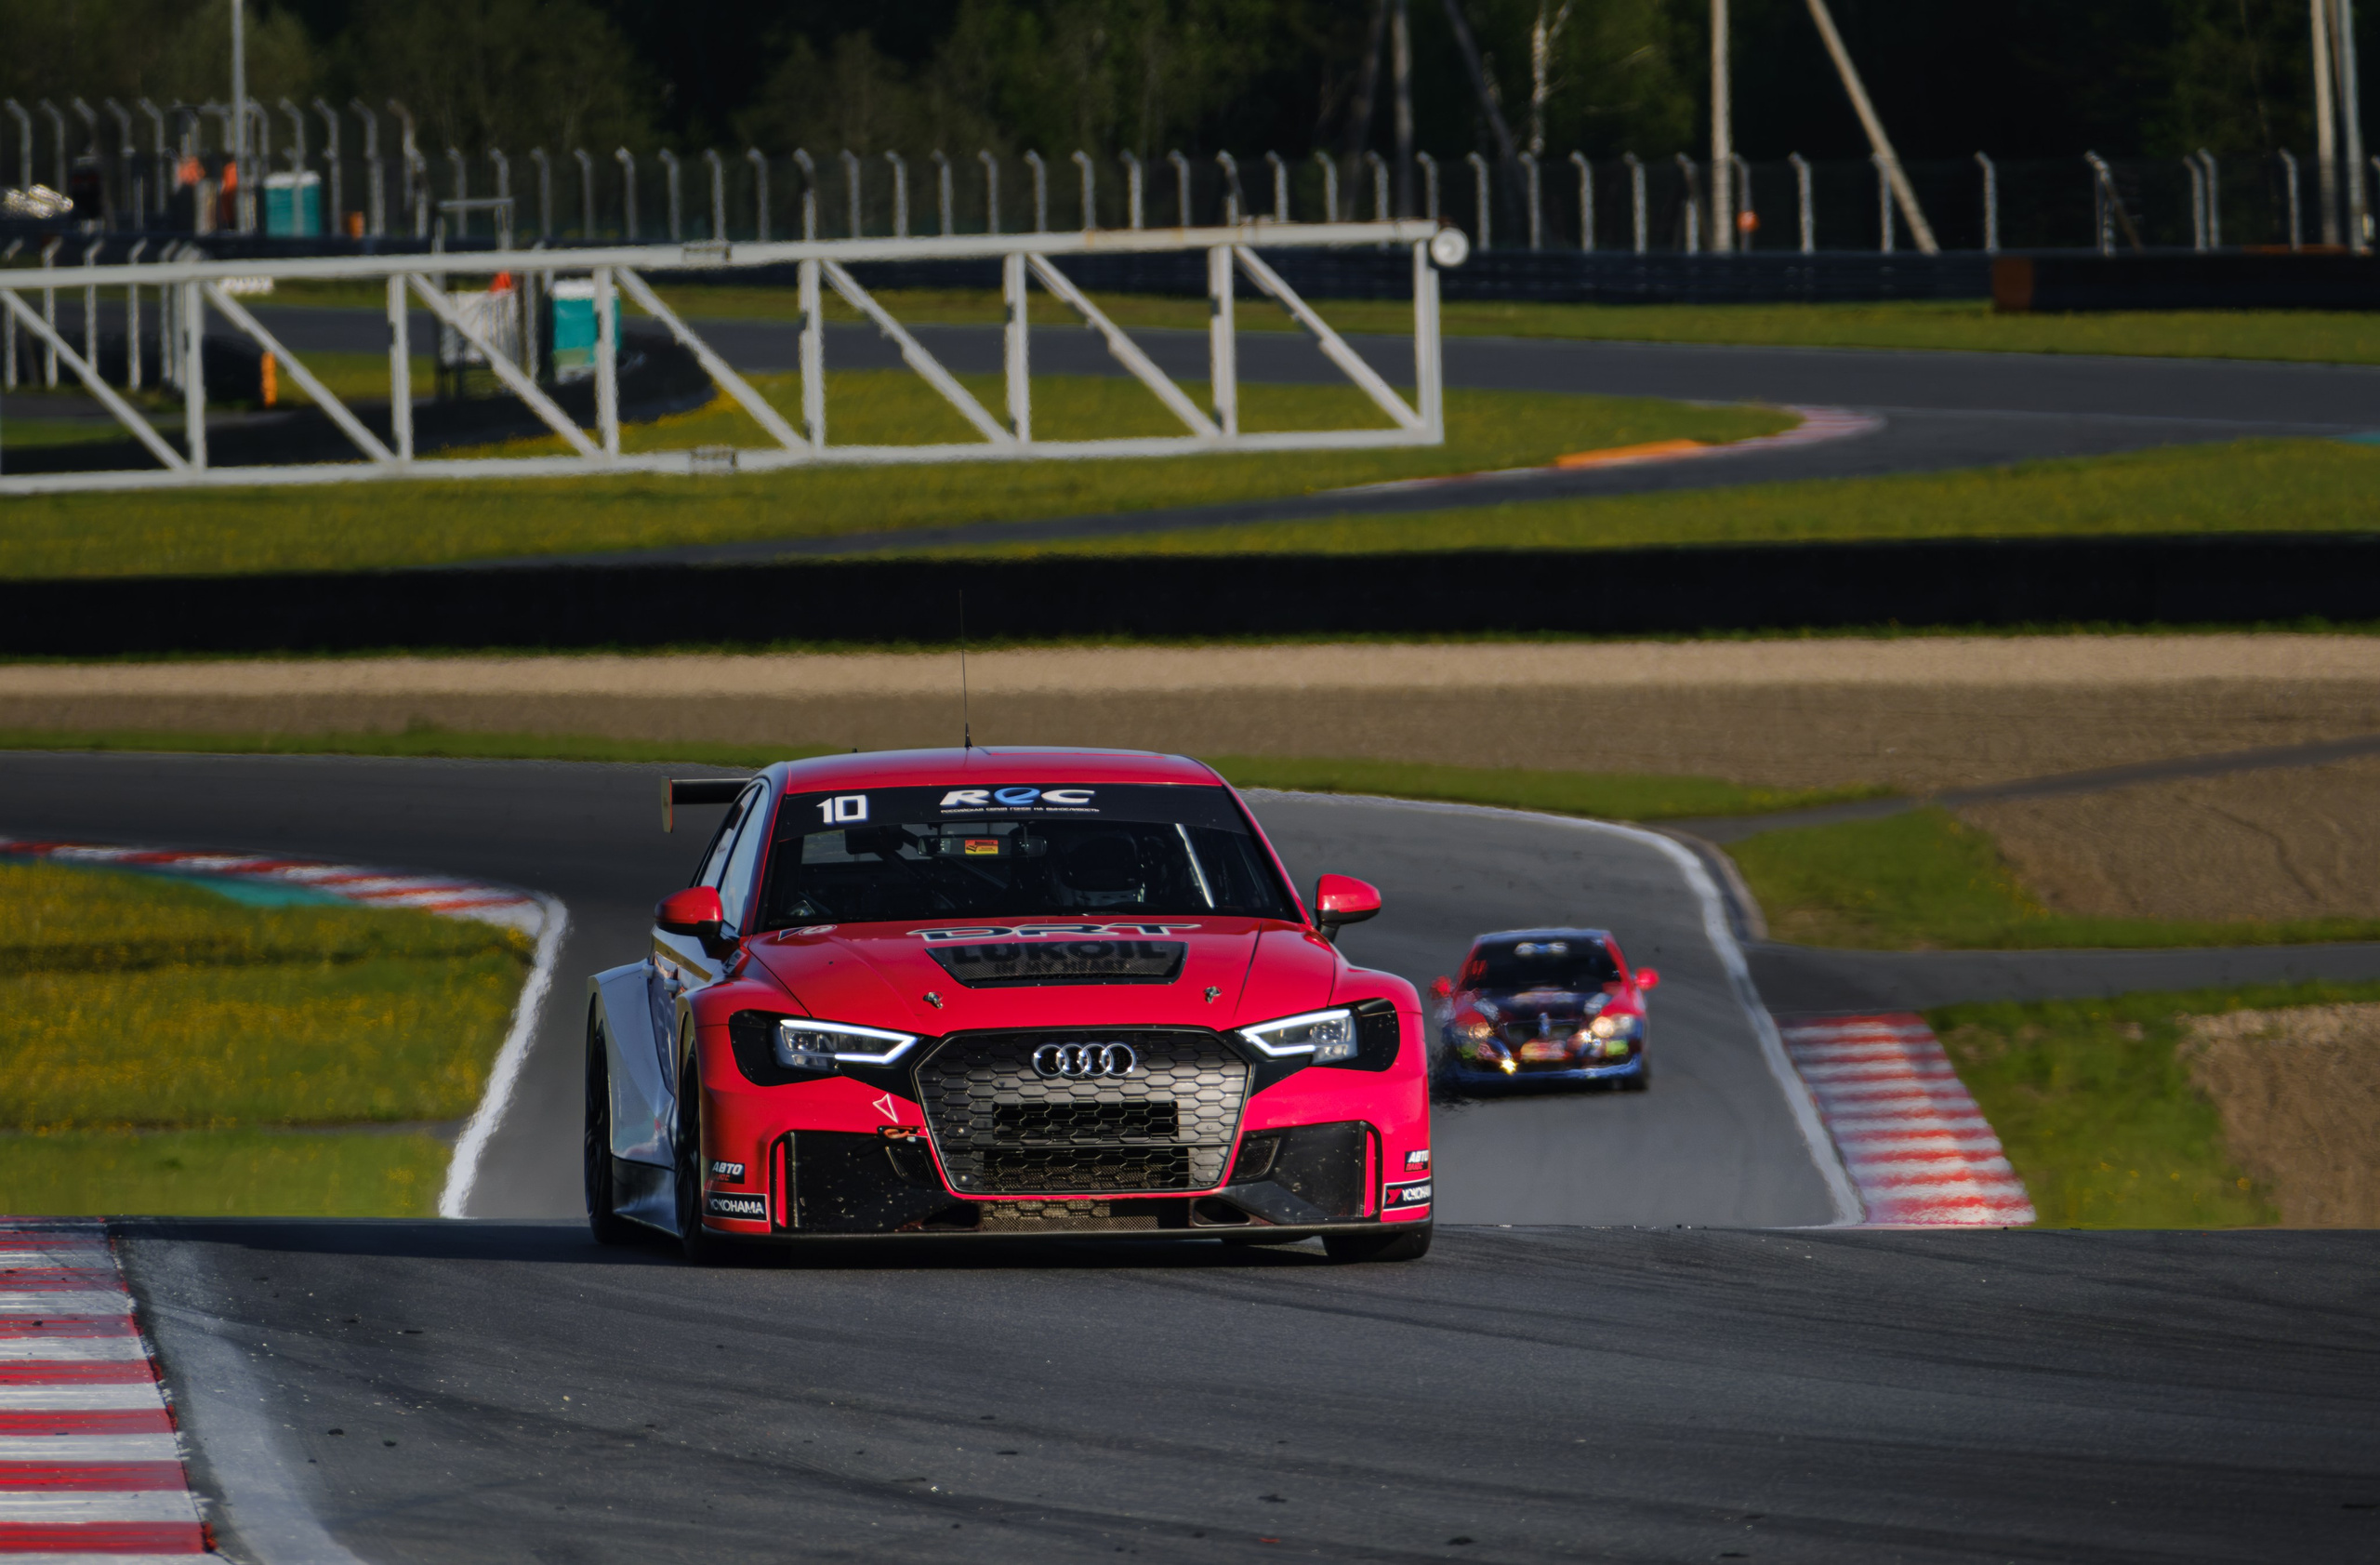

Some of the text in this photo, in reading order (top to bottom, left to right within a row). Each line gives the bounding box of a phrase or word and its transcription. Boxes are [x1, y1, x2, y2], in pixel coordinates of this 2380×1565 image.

[816, 793, 867, 824] 10
[906, 922, 1202, 942] DRT
[951, 940, 1167, 964] LUKOIL
[712, 1161, 744, 1175] АВТО
[709, 1199, 765, 1214] YOKOHAMA
